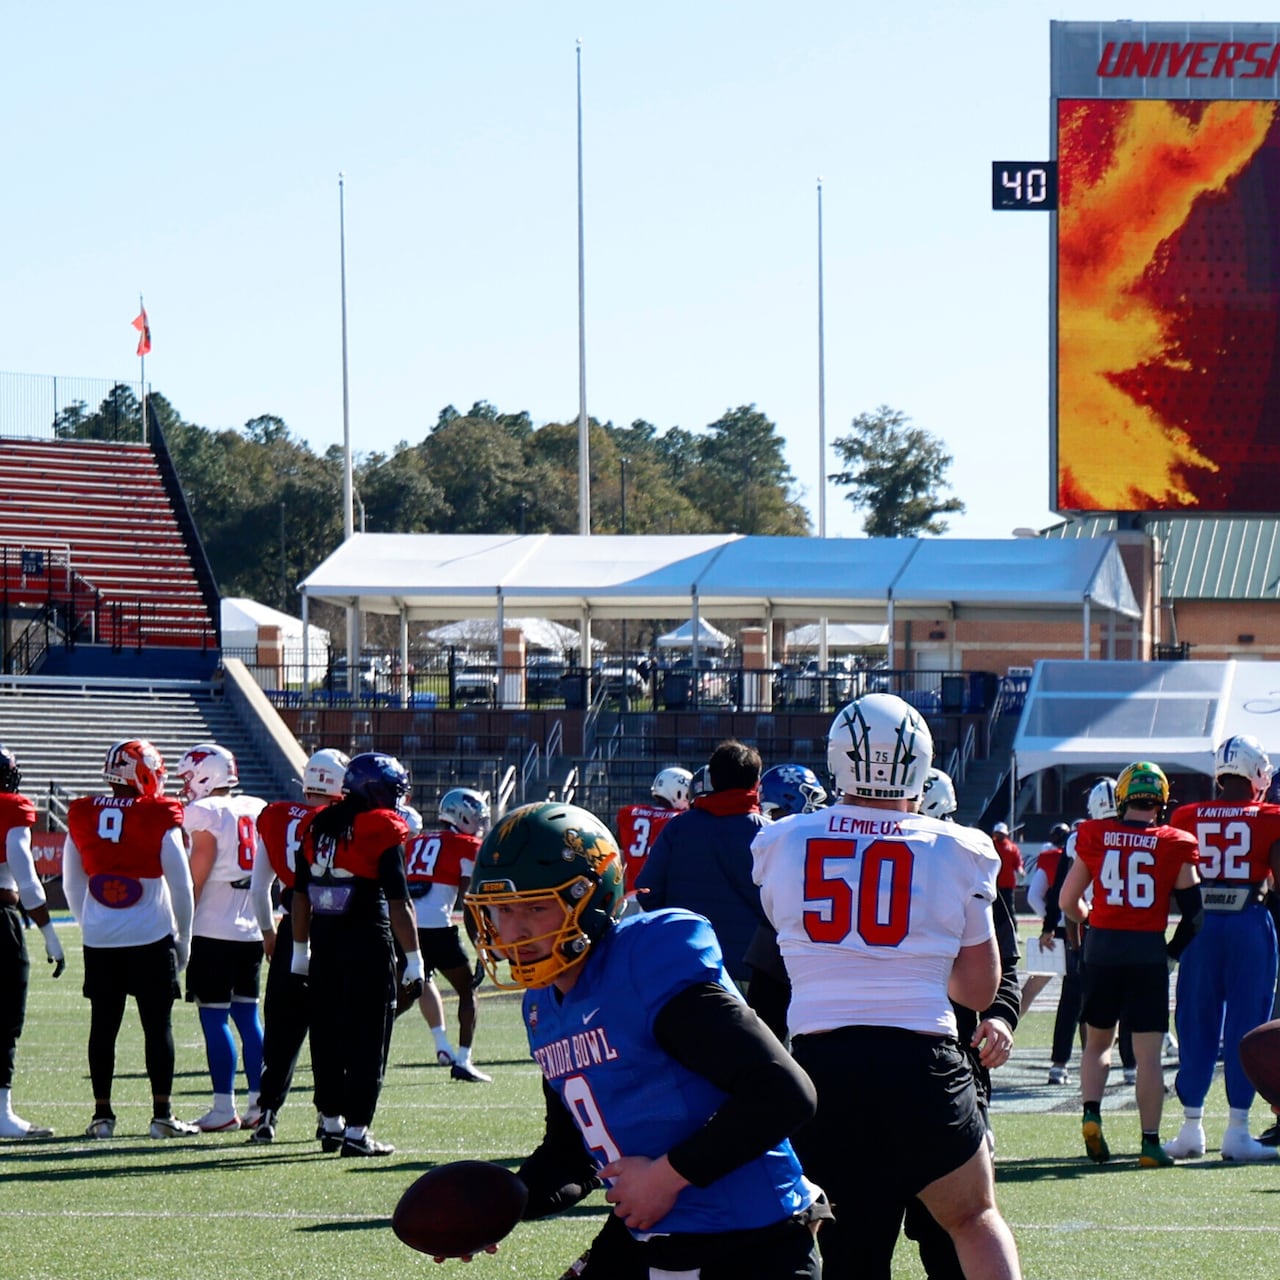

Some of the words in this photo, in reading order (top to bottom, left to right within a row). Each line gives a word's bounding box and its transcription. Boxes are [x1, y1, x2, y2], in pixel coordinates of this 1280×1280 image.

[1000, 168, 1047, 203] 40
[875, 751, 889, 763] 75
[92, 795, 135, 808] PARKER
[97, 807, 124, 844] 9
[828, 815, 904, 836] LEMIEUX
[1103, 831, 1159, 850] BOETTCHER
[406, 838, 442, 877] 19
[1196, 821, 1252, 880] 52
[803, 837, 915, 947] 50
[1100, 849, 1155, 909] 46
[1203, 893, 1237, 905] DOUGLAS
[533, 1035, 571, 1080] SENIOR
[572, 1026, 619, 1070] BOWL
[563, 1072, 625, 1185] 9
